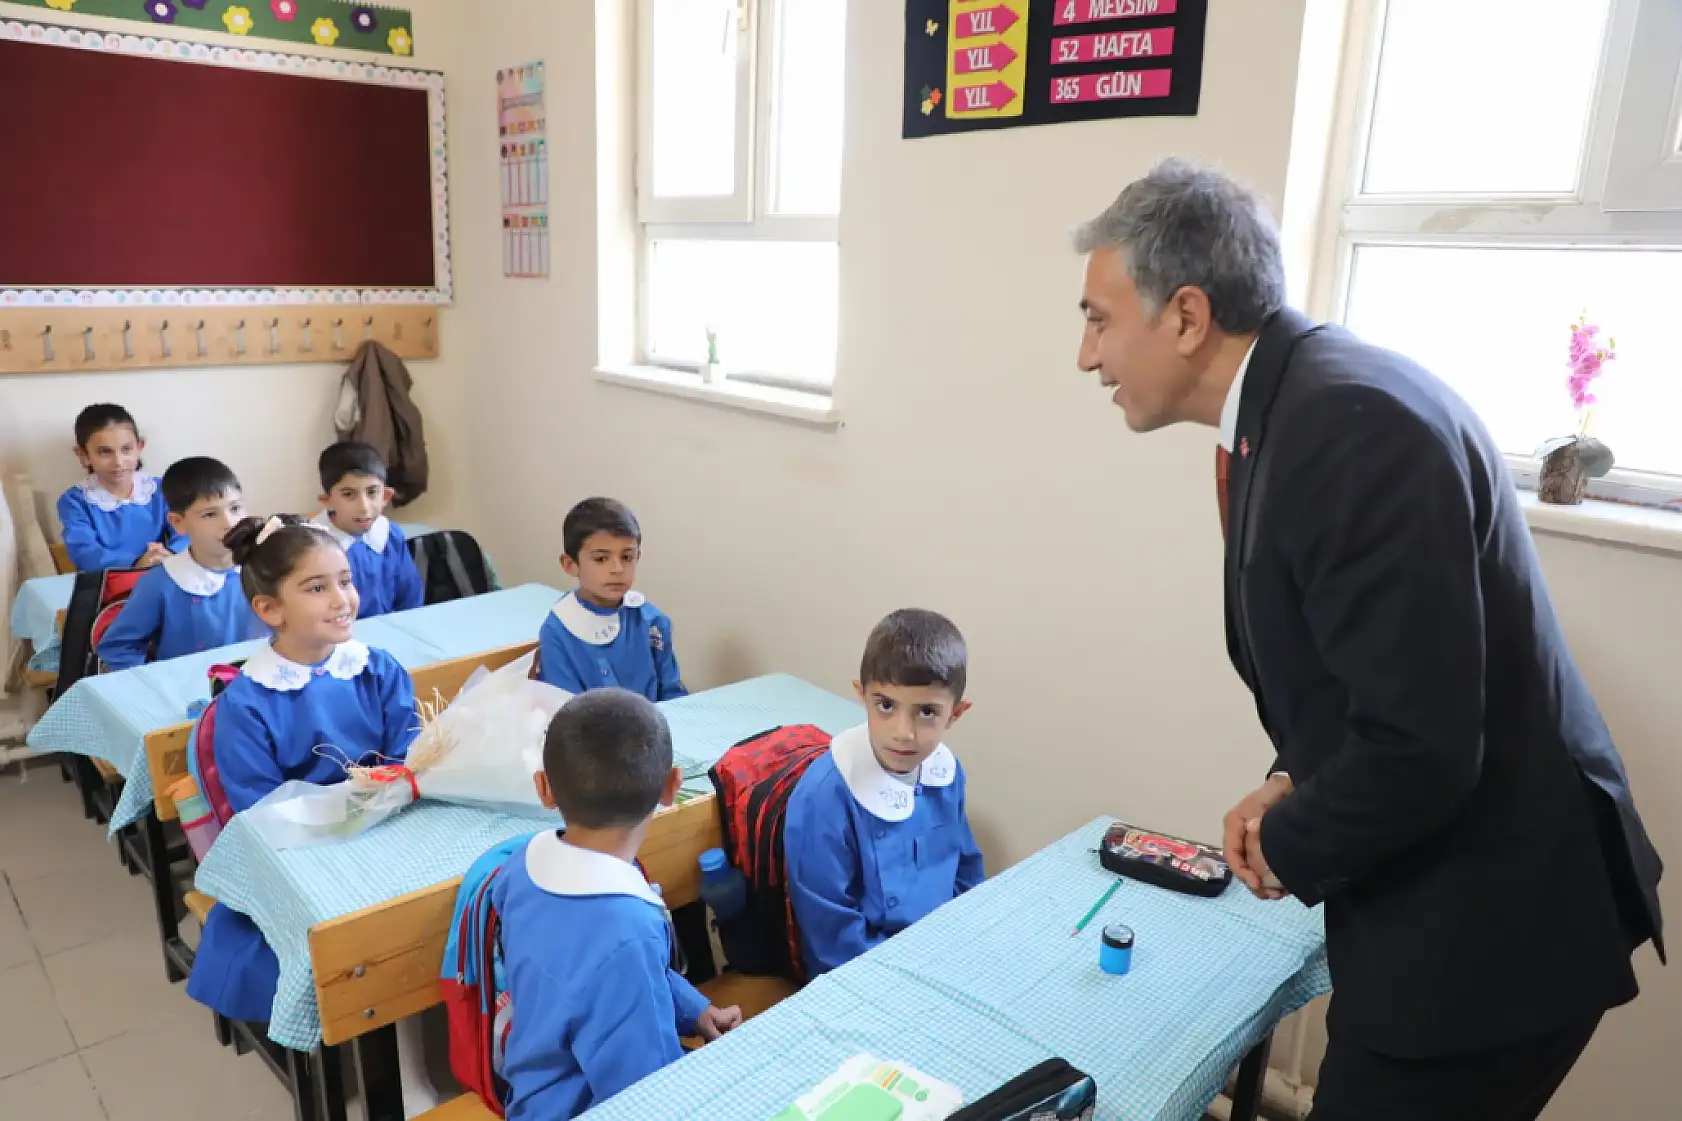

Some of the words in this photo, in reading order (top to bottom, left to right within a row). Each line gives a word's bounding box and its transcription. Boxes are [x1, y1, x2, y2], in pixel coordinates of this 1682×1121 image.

[970, 11, 995, 33] YIL
[1063, 0, 1076, 22] 4
[1059, 40, 1079, 62] 52
[1093, 32, 1153, 58] HAFTA
[967, 47, 993, 70] YIL
[1056, 78, 1080, 100] 365
[1096, 70, 1142, 98] GÜN
[965, 87, 992, 108] YIL
